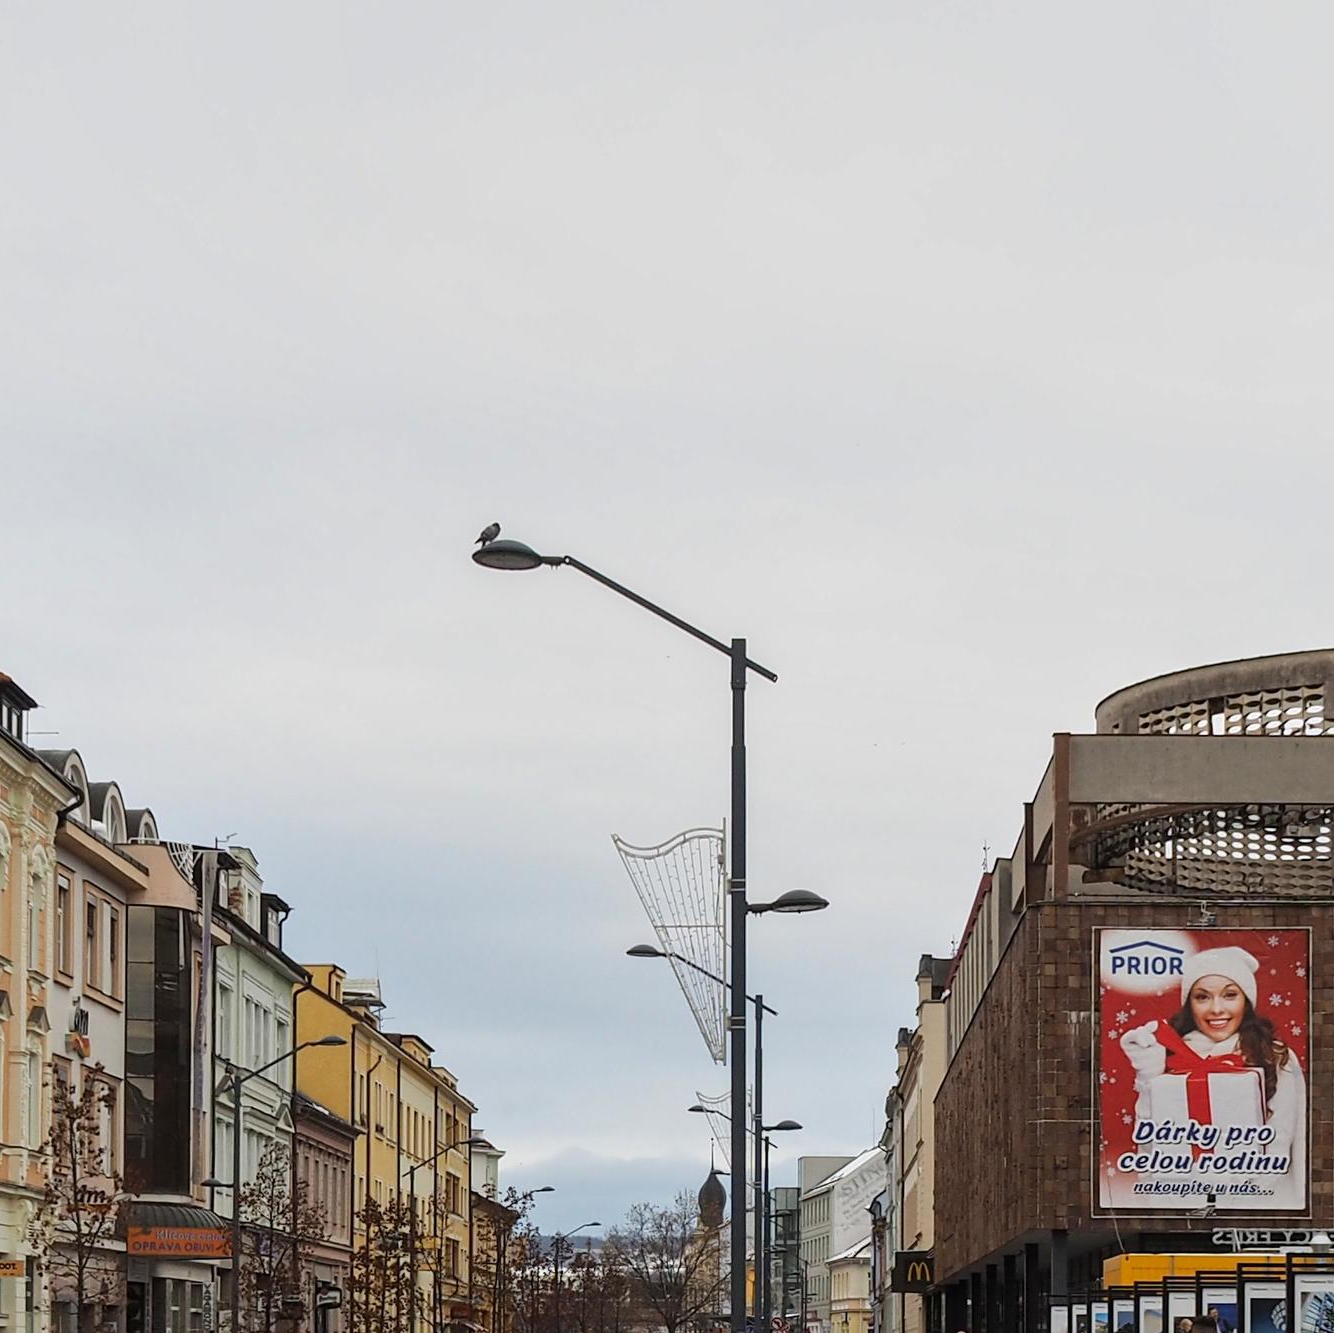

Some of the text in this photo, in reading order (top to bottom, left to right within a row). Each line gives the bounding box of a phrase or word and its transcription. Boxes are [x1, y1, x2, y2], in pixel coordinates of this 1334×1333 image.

[1112, 956, 1184, 975] PRIOR
[1135, 1121, 1274, 1146] Dárky pro
[1120, 1151, 1290, 1173] celou rodinu
[1134, 1181, 1211, 1196] nakoupíte
[1216, 1184, 1226, 1194] u
[132, 1241, 181, 1252] OPRAVA
